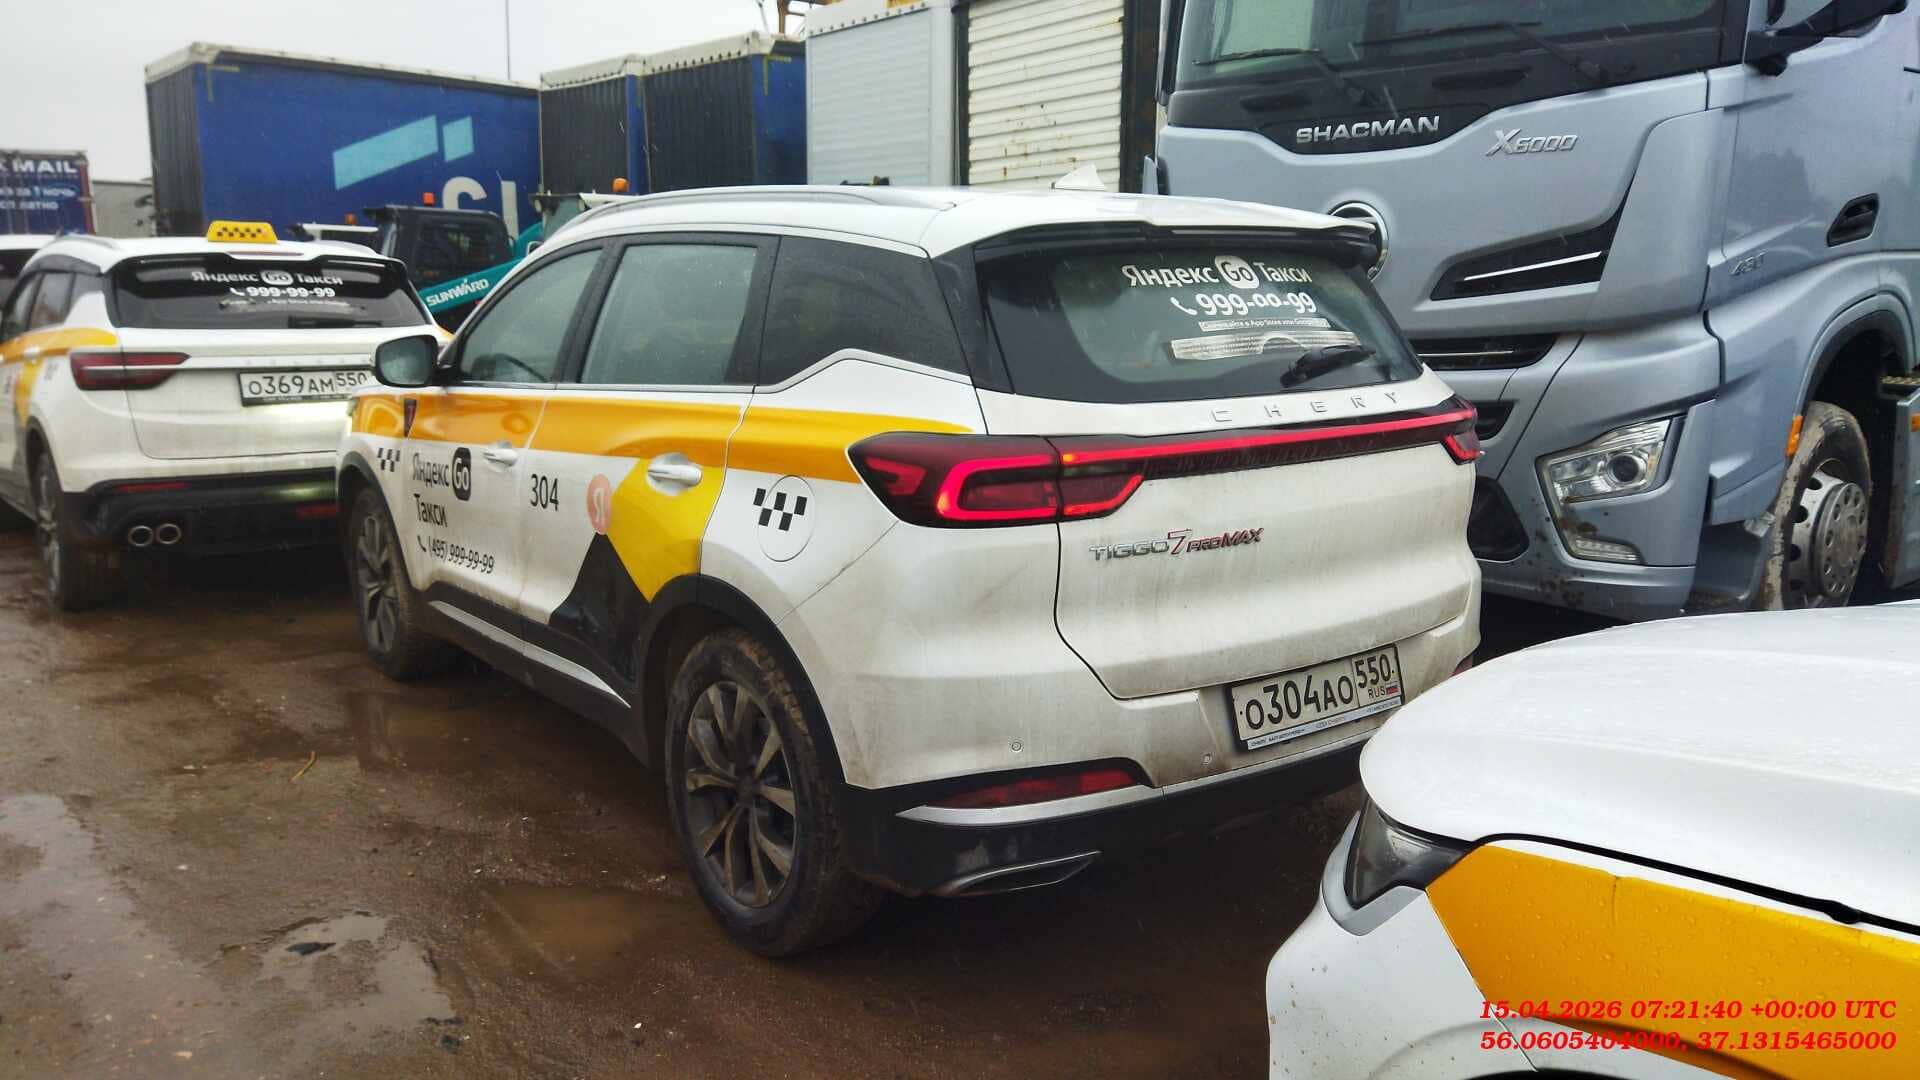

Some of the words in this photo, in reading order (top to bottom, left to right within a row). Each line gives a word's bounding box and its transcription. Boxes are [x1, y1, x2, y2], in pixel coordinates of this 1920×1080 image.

[1296, 115, 1440, 144] SHACMAN
[1485, 128, 1580, 157] X6000
[12, 159, 78, 173] MAIL
[191, 271, 259, 283] Яндекс
[294, 273, 343, 285] Такси
[1121, 263, 1219, 288] Яндекс
[1222, 261, 1254, 283] Go
[1254, 261, 1312, 283] Такси
[246, 286, 335, 297] 999-99-99
[426, 278, 489, 306] SUNWARD
[248, 375, 334, 396] О369АМ
[1211, 391, 1399, 423] CHERY
[412, 452, 450, 488] Яндекс
[530, 473, 559, 511] 304
[413, 493, 448, 528] Такси
[428, 536, 448, 562] (495)
[447, 549, 495, 574] 999-99-99
[1245, 675, 1354, 730] О304АО
[1354, 653, 1392, 689] 550
[1367, 685, 1386, 699] RUS
